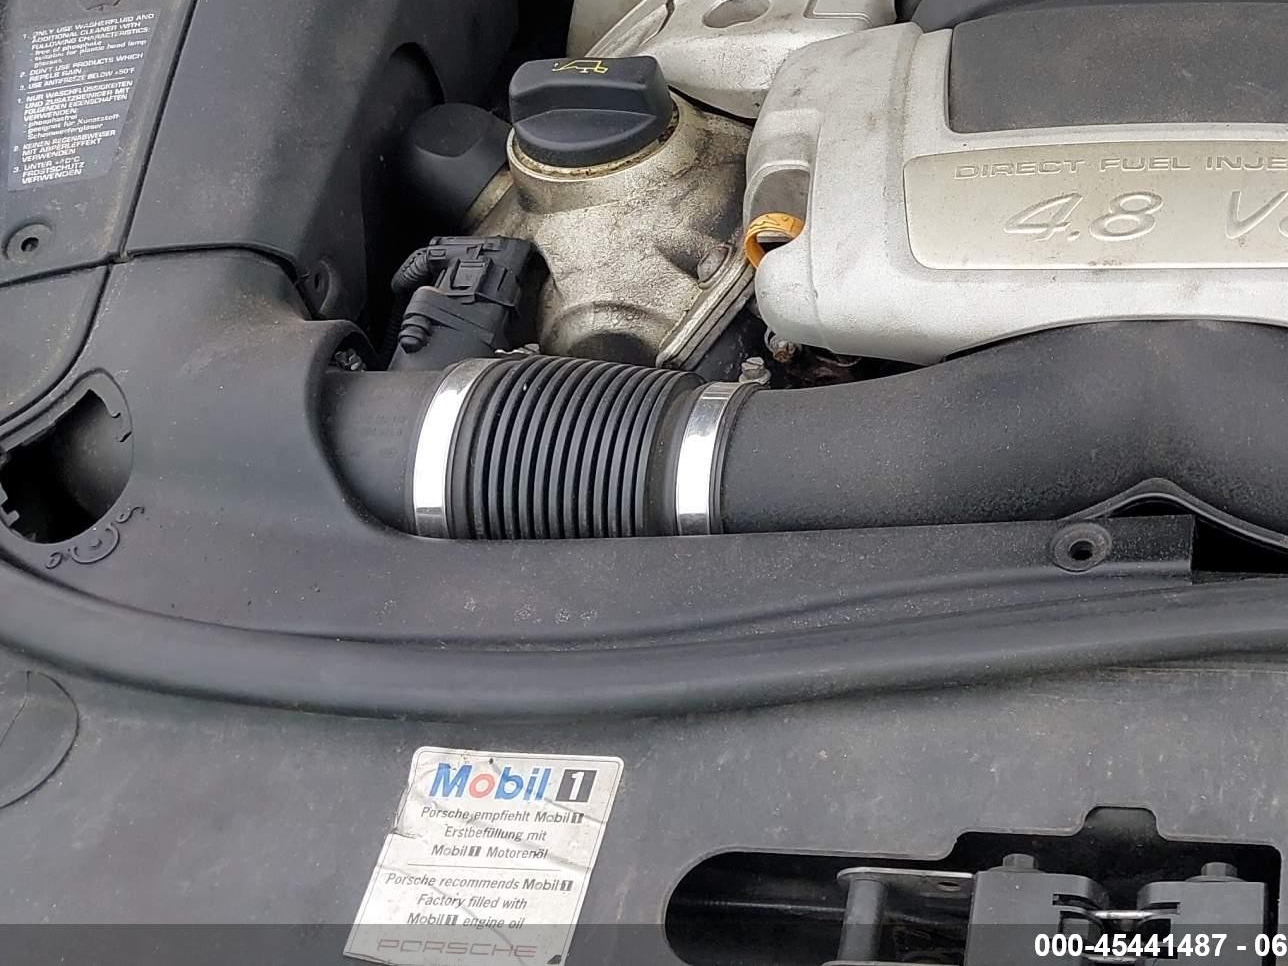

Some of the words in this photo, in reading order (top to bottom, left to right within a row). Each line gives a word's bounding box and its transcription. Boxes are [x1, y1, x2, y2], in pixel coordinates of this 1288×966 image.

[32, 31, 78, 43] ADDITIONAL
[81, 25, 117, 35] CLEANER
[120, 21, 141, 29] WITH
[57, 25, 72, 33] USE
[32, 37, 76, 49] FOLLOWING
[73, 57, 113, 68] PRODUCTS
[116, 52, 143, 62] WHICH
[62, 68, 82, 76] RAIN
[88, 70, 113, 79] BELOW
[25, 100, 43, 108] UND
[27, 93, 43, 101] NUR
[24, 103, 66, 114] FOLGENDEN
[23, 139, 50, 149] KEINEN
[53, 129, 115, 145] REGENABWEISER
[22, 148, 76, 162] VERWENDEN
[23, 161, 85, 177] FROSTSCHUTZ
[24, 160, 52, 170] UNTER
[954, 160, 1085, 180] DIRECT
[1100, 156, 1191, 172] FUEL
[22, 168, 81, 184] VERWENDEN
[1002, 191, 1164, 242] 4.8
[429, 762, 552, 801] Mobil
[421, 806, 474, 821] Porsche
[474, 810, 530, 824] empfiehlt
[526, 829, 548, 841] mit
[486, 847, 549, 859] Motorenöl
[385, 872, 436, 886] Porsche
[439, 877, 519, 889] recommends
[417, 893, 465, 907] Factory
[468, 895, 498, 908] filled
[502, 897, 527, 910] with
[462, 918, 508, 930] engine
[508, 918, 526, 929] oil
[377, 939, 537, 957] PORSCHE
